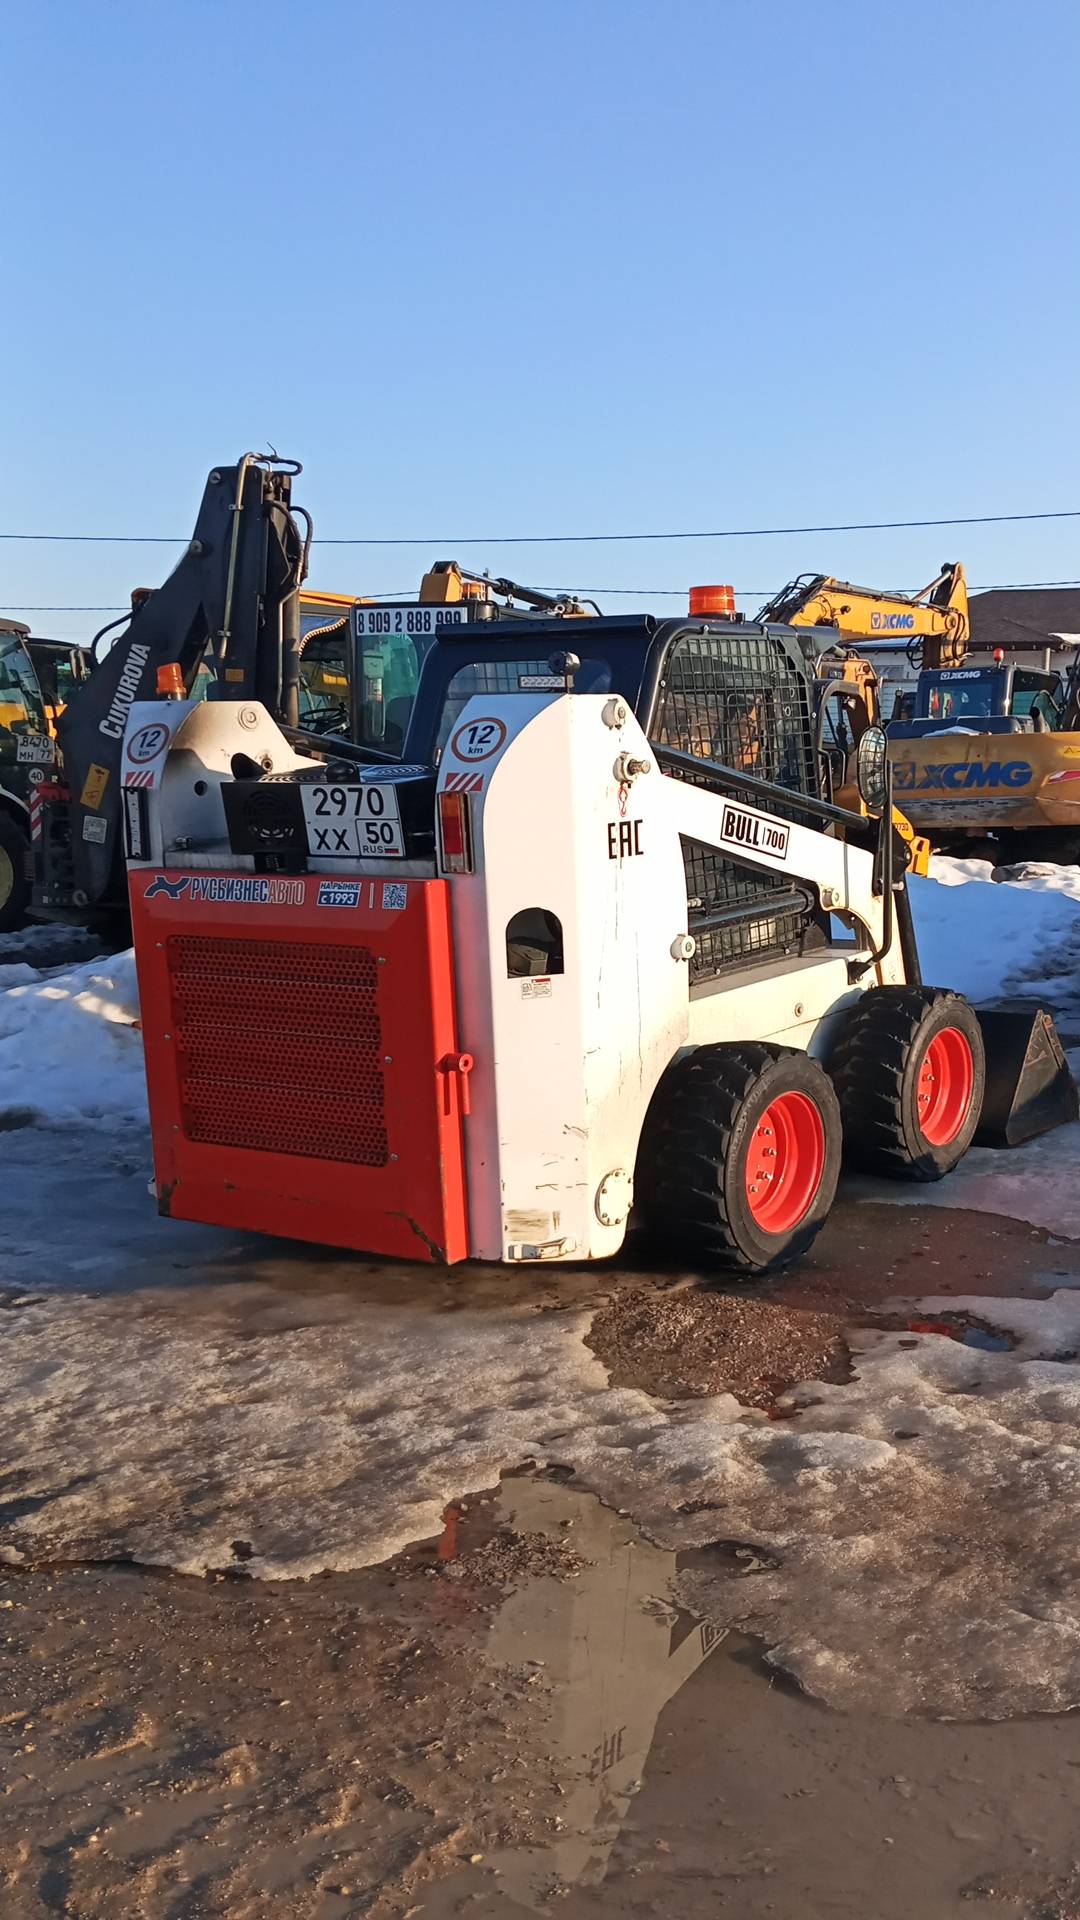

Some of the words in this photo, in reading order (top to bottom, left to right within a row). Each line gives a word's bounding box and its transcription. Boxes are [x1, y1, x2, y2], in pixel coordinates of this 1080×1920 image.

[358, 613, 365, 633] 8
[368, 611, 391, 633] 909
[395, 612, 402, 632] 2
[406, 610, 432, 632] 888
[882, 613, 914, 629] XCMG
[950, 670, 981, 680] XCMG
[99, 643, 151, 739] CUKUROVA
[139, 730, 161, 748] 12
[468, 725, 495, 744] 12
[467, 746, 484, 755] km
[31, 771, 42, 781] 40
[918, 760, 1033, 789] XCMG
[312, 787, 385, 817] 2970
[365, 822, 394, 844] 50
[724, 810, 760, 846] BULL
[766, 827, 786, 850] 700
[362, 845, 384, 854] RUS
[191, 877, 305, 905] РУСБИЗНЕСАВТО
